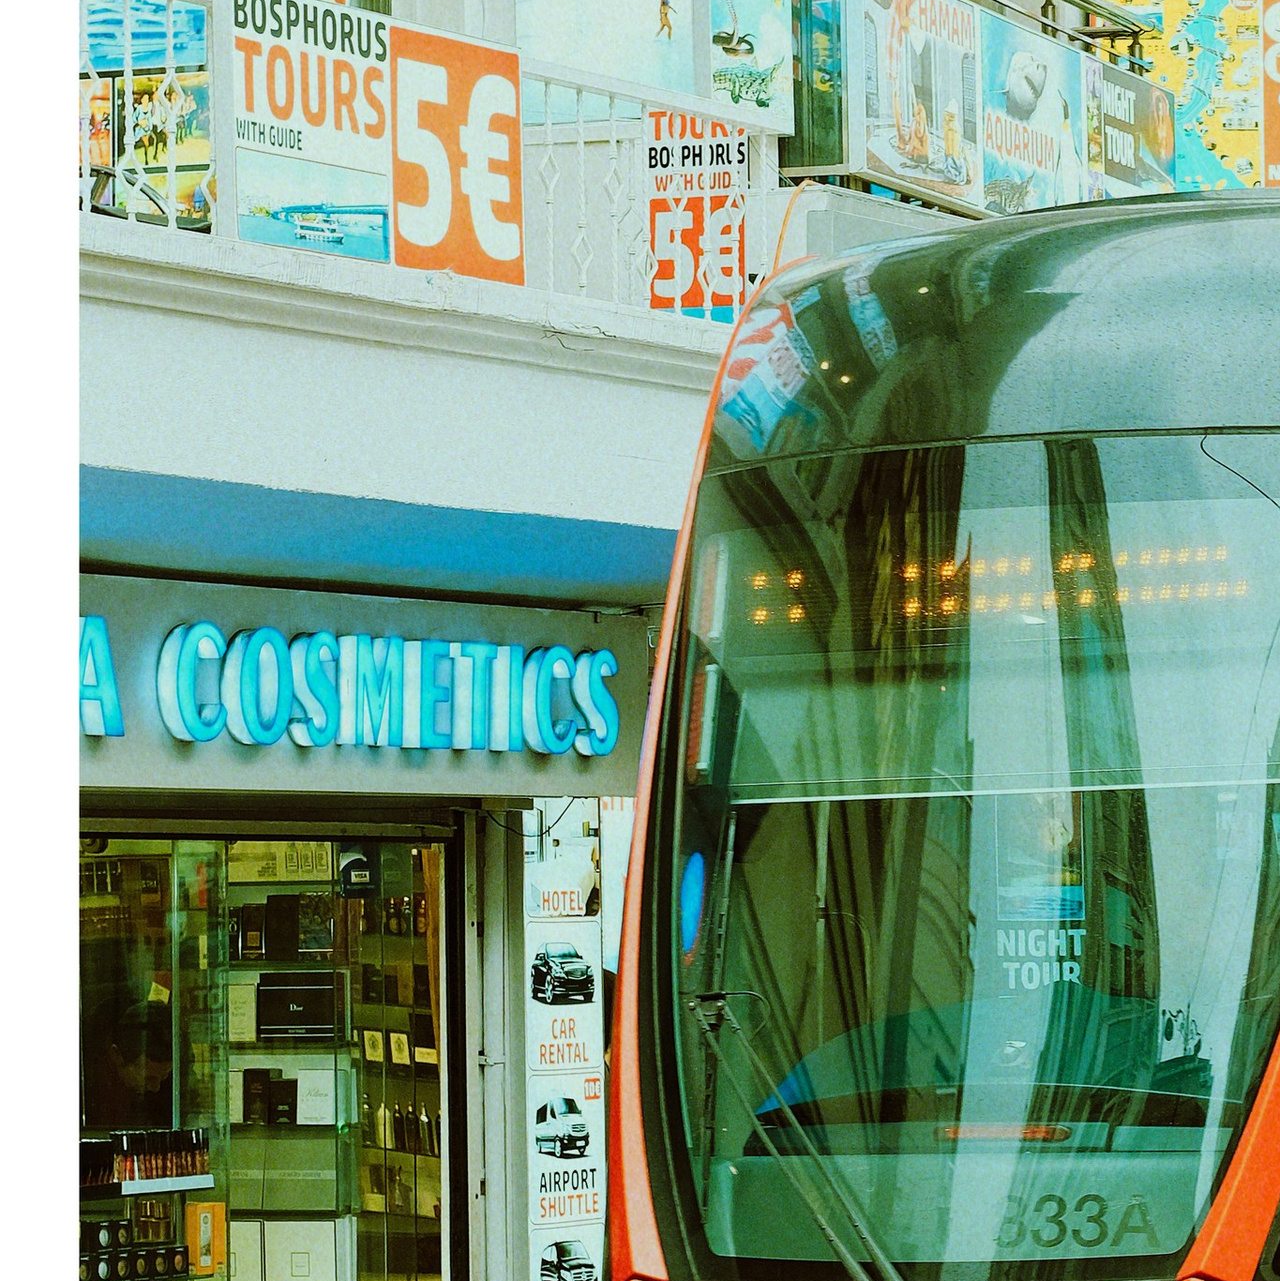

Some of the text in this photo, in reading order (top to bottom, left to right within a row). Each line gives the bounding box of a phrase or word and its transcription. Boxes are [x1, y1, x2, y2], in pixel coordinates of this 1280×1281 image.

[235, 35, 387, 140] TOURS
[1103, 80, 1137, 125] NIGHT
[236, 117, 303, 151] WITH GUIDE
[985, 111, 1055, 173] AQUARIUM
[1105, 125, 1136, 170] TOUR
[397, 56, 521, 262] 5€
[79, 614, 619, 758] A COSMETICS
[542, 890, 584, 913] HOTEL
[996, 929, 1087, 957] NIGHT
[1002, 961, 1081, 990] TOUR
[551, 1017, 577, 1041] CAR
[539, 1041, 589, 1066] RENTAL
[539, 1168, 597, 1194] AIRPORT
[539, 1192, 600, 1219] SHUTTLE
